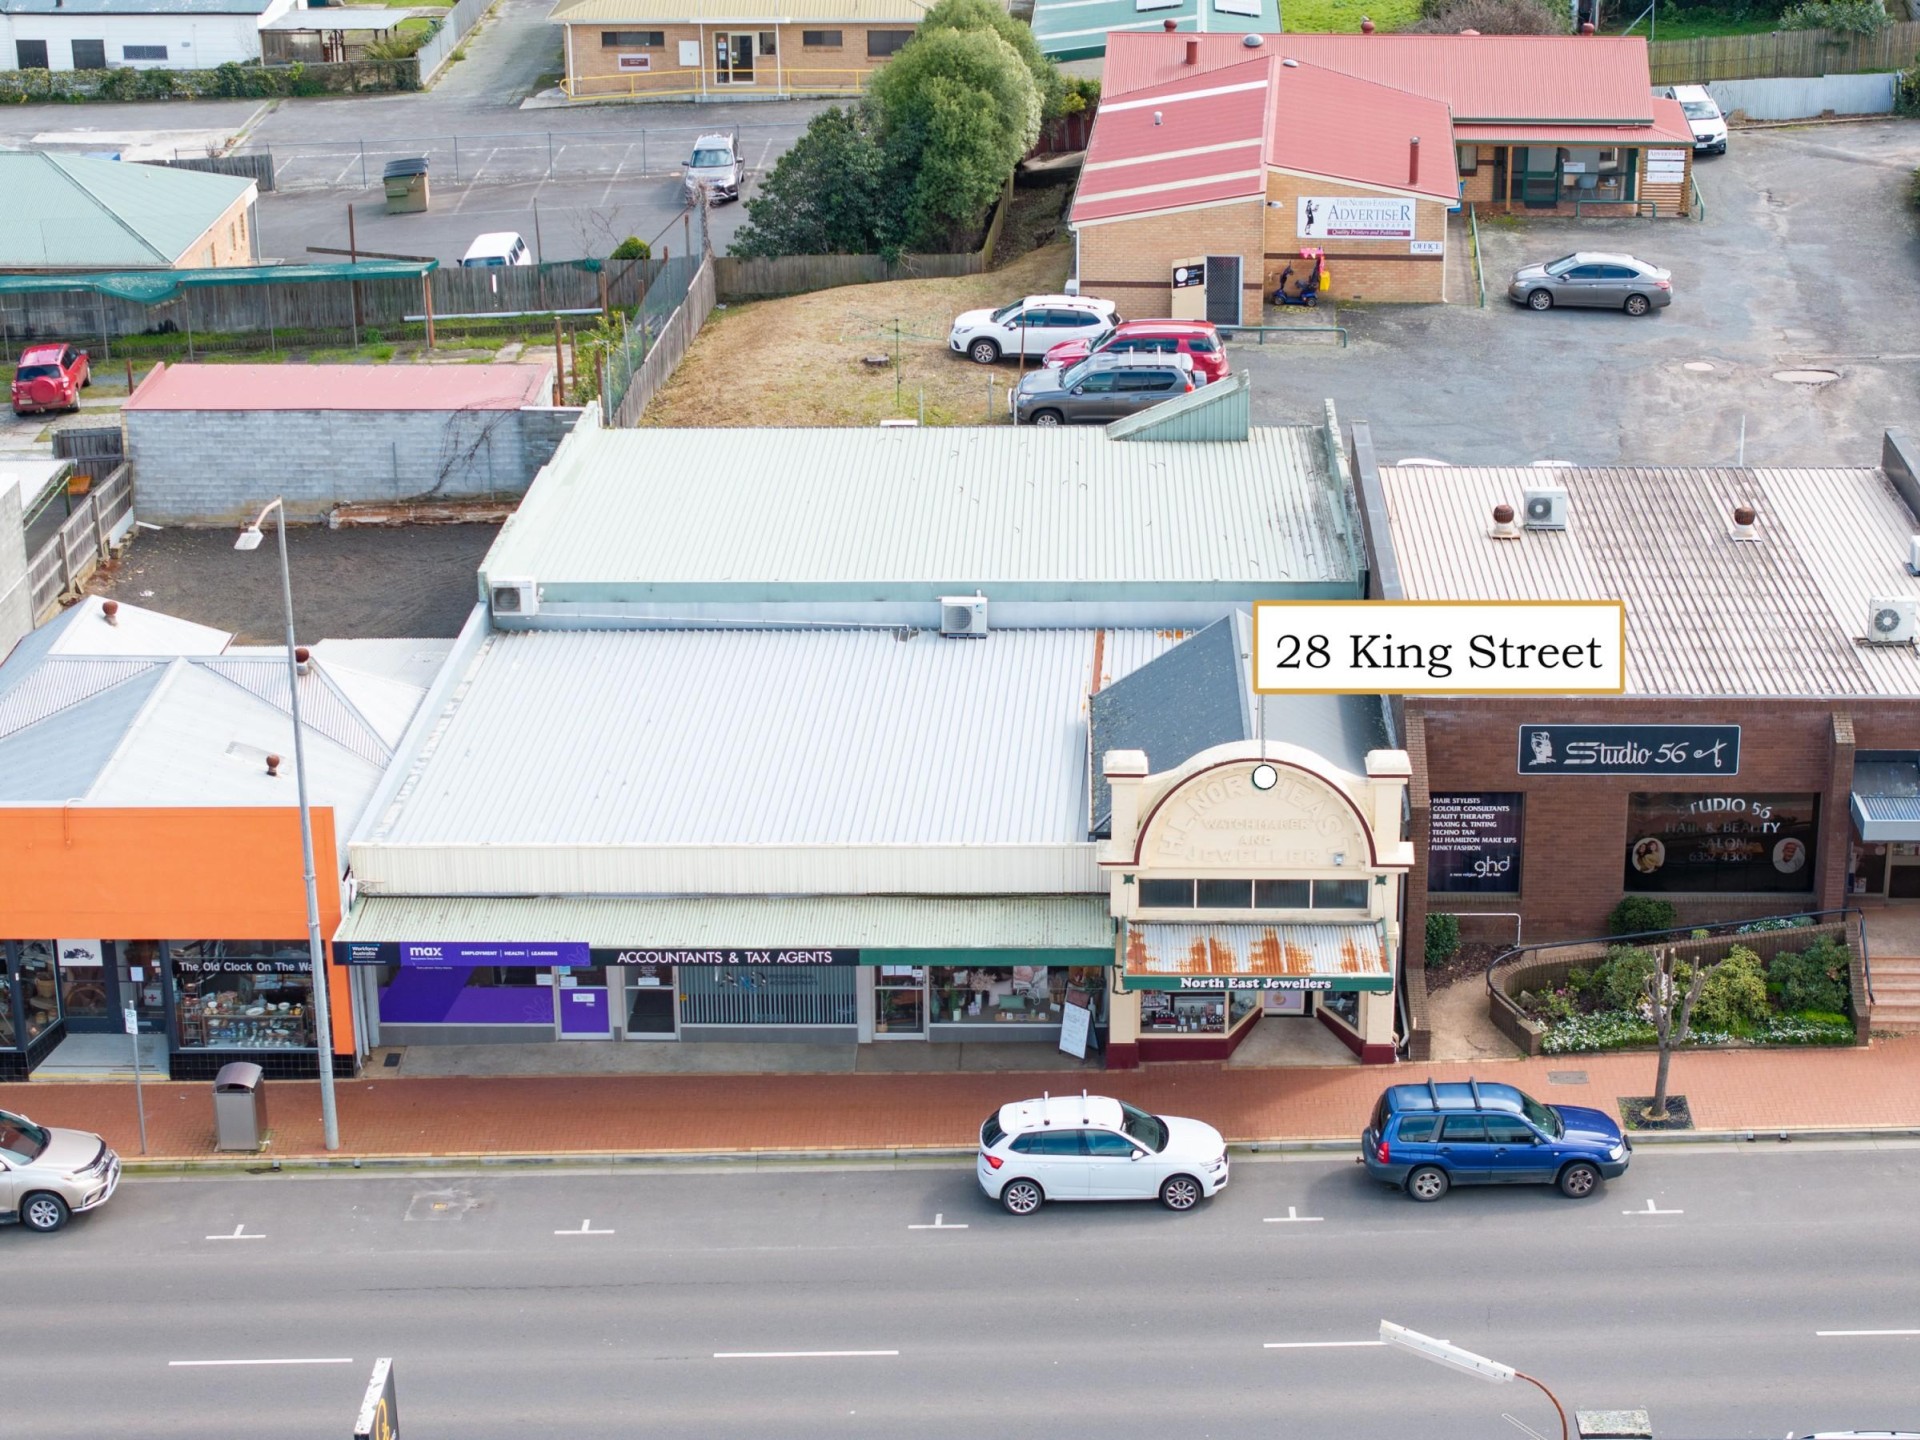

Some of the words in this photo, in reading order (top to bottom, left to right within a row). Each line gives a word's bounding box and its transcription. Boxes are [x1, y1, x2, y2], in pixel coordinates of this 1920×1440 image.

[1328, 204, 1411, 221] ADVERTISER
[1413, 242, 1440, 250] OFFICE
[1563, 741, 1653, 765] Studio
[1654, 742, 1690, 763] 56
[1752, 802, 1772, 819] 56
[1203, 819, 1312, 831] WATCHMAKER
[1706, 822, 1716, 833] &
[1239, 836, 1274, 846] AND
[1698, 838, 1747, 850] SALON
[1186, 848, 1319, 864] JEWELLER
[1474, 855, 1510, 878] ghd
[409, 947, 443, 956] max
[617, 951, 723, 963] ACCOUNTANTS
[729, 951, 739, 963] &
[745, 951, 771, 963] TAX
[776, 951, 833, 963] AGENTS
[179, 962, 199, 971] The
[203, 962, 220, 971] Old
[224, 962, 253, 971] Clock
[256, 962, 272, 971] On
[275, 962, 295, 971] The
[298, 962, 313, 971] Wa
[1180, 977, 1225, 989] North
[1228, 977, 1259, 989] East
[1263, 977, 1332, 990] Jewellers
